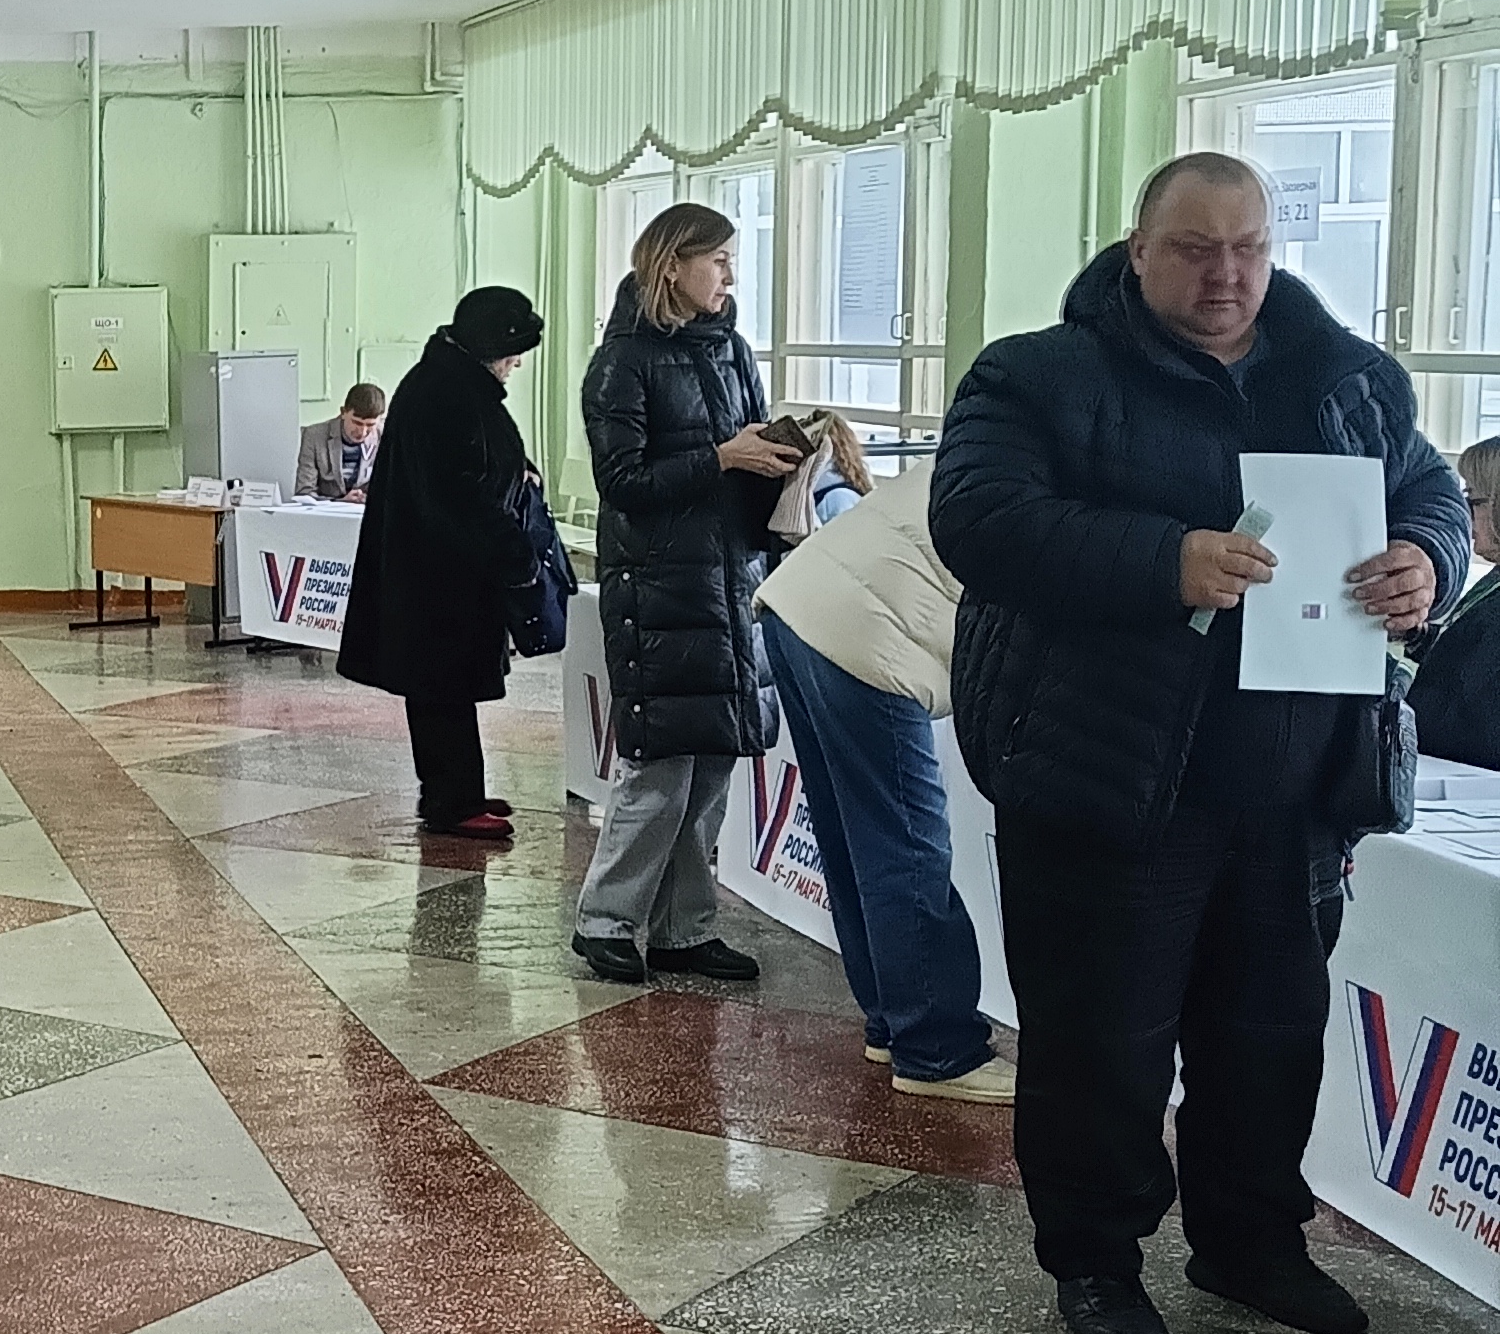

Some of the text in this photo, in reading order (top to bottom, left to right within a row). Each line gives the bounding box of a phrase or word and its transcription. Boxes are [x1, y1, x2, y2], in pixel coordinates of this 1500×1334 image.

[1295, 203, 1309, 220] 21
[95, 319, 118, 328] ЩО-1
[309, 559, 351, 578] ВЫБОРЫ
[299, 595, 337, 614] РОССИИ
[314, 617, 337, 633] МАРТА
[794, 874, 824, 906] МАРТА
[1452, 1090, 1500, 1150] ПРЕ
[1439, 1138, 1500, 1206] РОСС
